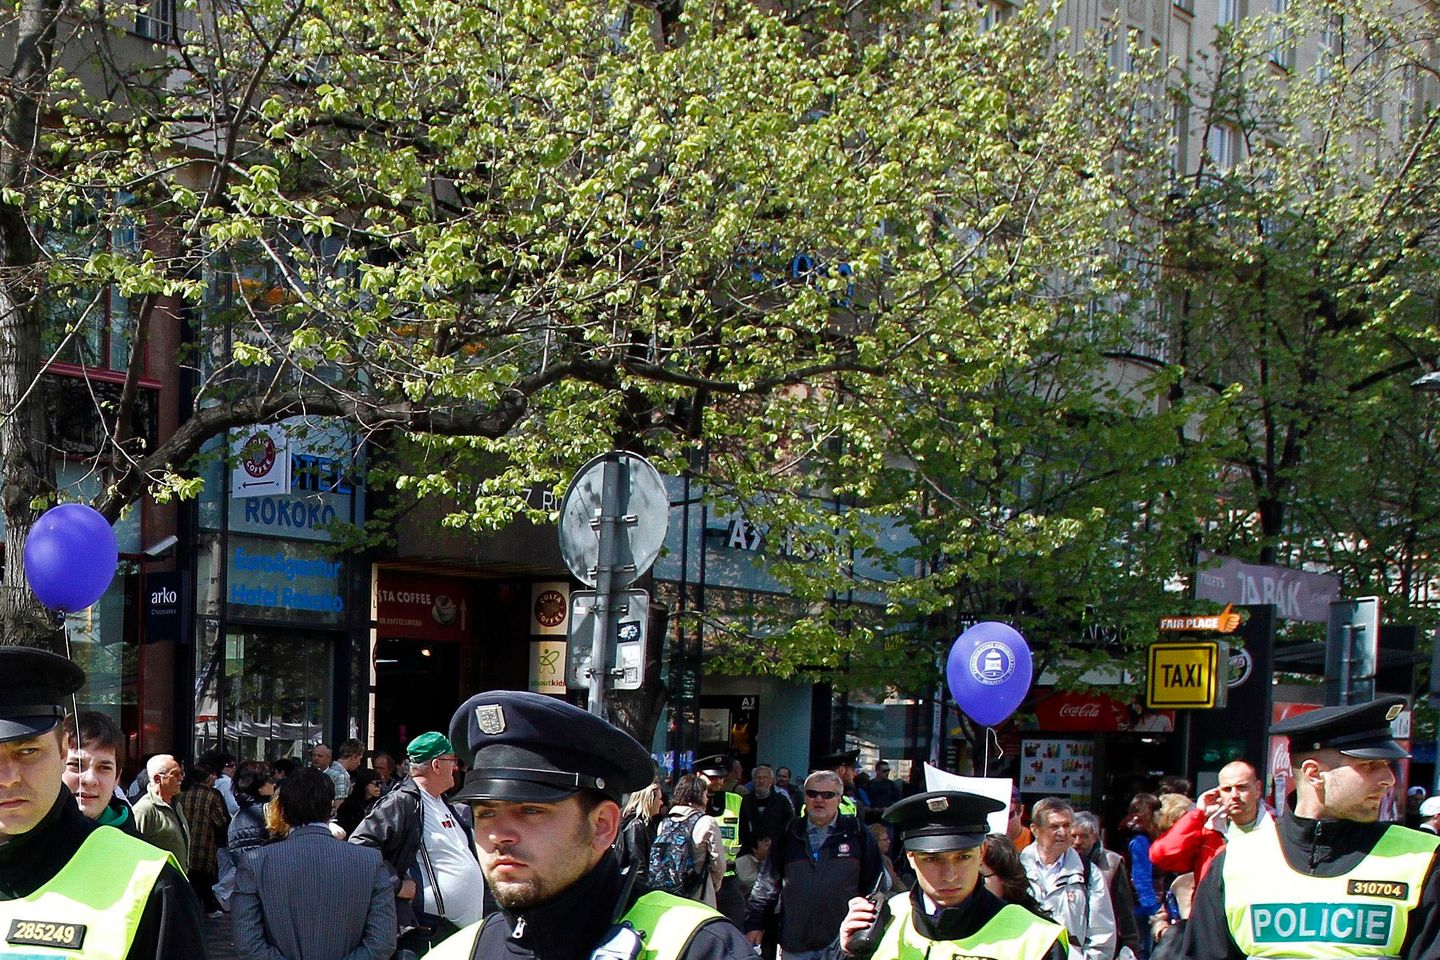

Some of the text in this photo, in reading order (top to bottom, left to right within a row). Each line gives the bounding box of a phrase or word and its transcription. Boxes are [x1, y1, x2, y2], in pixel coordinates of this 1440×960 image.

[245, 497, 336, 528] ROKOKO
[151, 586, 177, 604] arko
[1160, 616, 1219, 629] FAIR PLACE
[1161, 664, 1202, 688] TAXI
[1354, 882, 1402, 896] 310704
[14, 922, 76, 943] 285249
[1253, 908, 1388, 940] POLICIE
